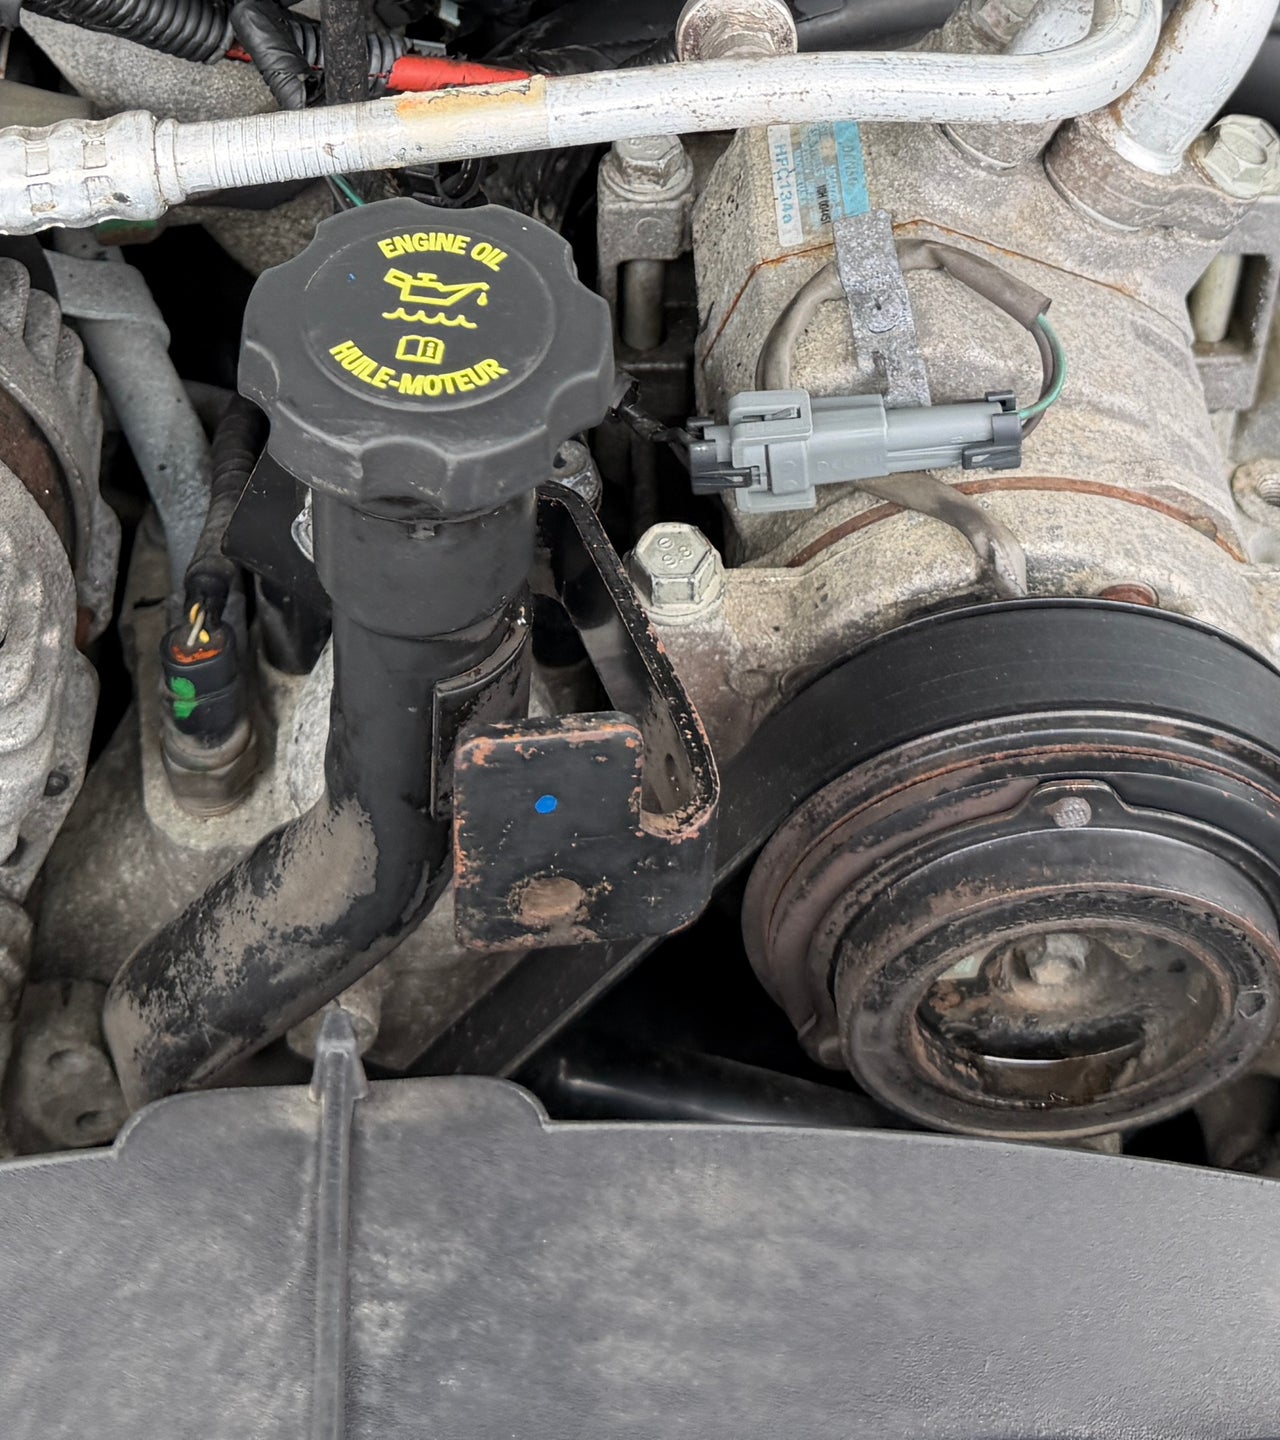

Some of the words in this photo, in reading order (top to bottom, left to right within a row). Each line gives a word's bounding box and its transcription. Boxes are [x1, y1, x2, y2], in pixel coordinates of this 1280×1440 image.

[377, 232, 471, 260] ENGINE
[471, 241, 509, 272] OIL
[329, 339, 510, 397] HUILE-MOTEUR
